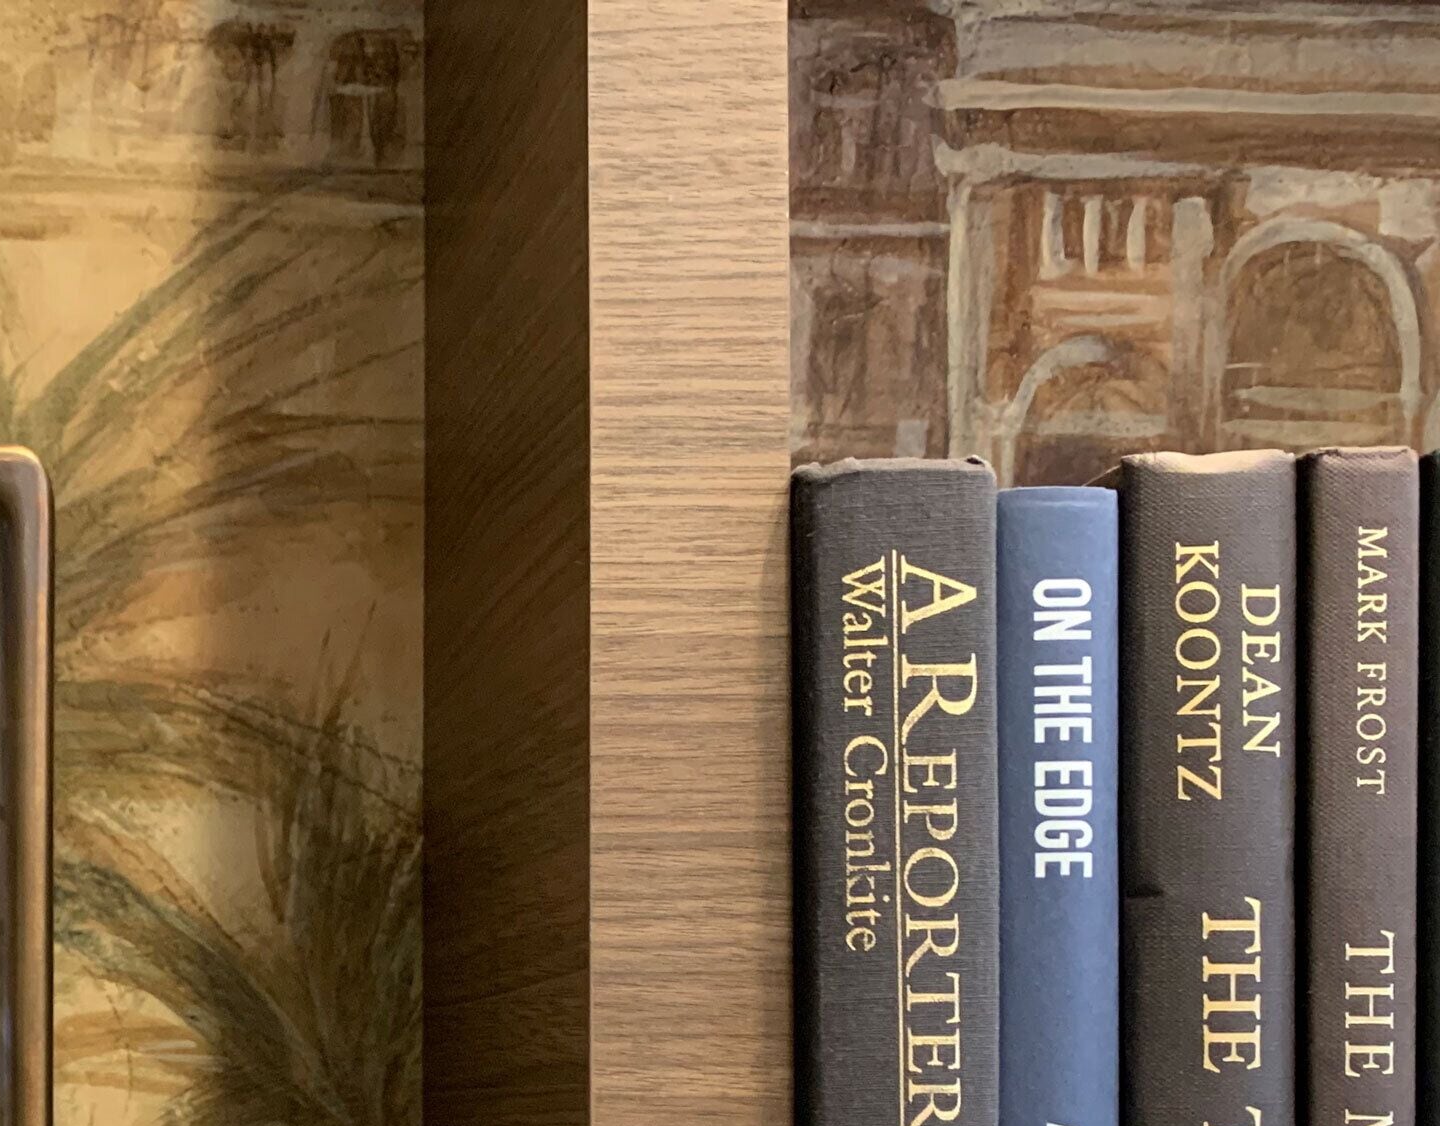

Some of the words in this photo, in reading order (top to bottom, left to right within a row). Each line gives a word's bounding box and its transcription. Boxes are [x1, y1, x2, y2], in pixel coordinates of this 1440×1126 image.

[841, 554, 887, 716] Walter
[900, 554, 978, 635] A
[1032, 578, 1092, 642] ON
[1357, 525, 1389, 645] MARK
[1033, 656, 1093, 744] THE
[1174, 540, 1223, 802] KOONTZ
[1240, 583, 1282, 757] DEAN
[1356, 661, 1388, 796] FROST
[843, 735, 890, 953] Cronkite
[1034, 760, 1093, 879] EDGE
[1202, 896, 1262, 1075] THE
[1344, 929, 1396, 1079] THE
